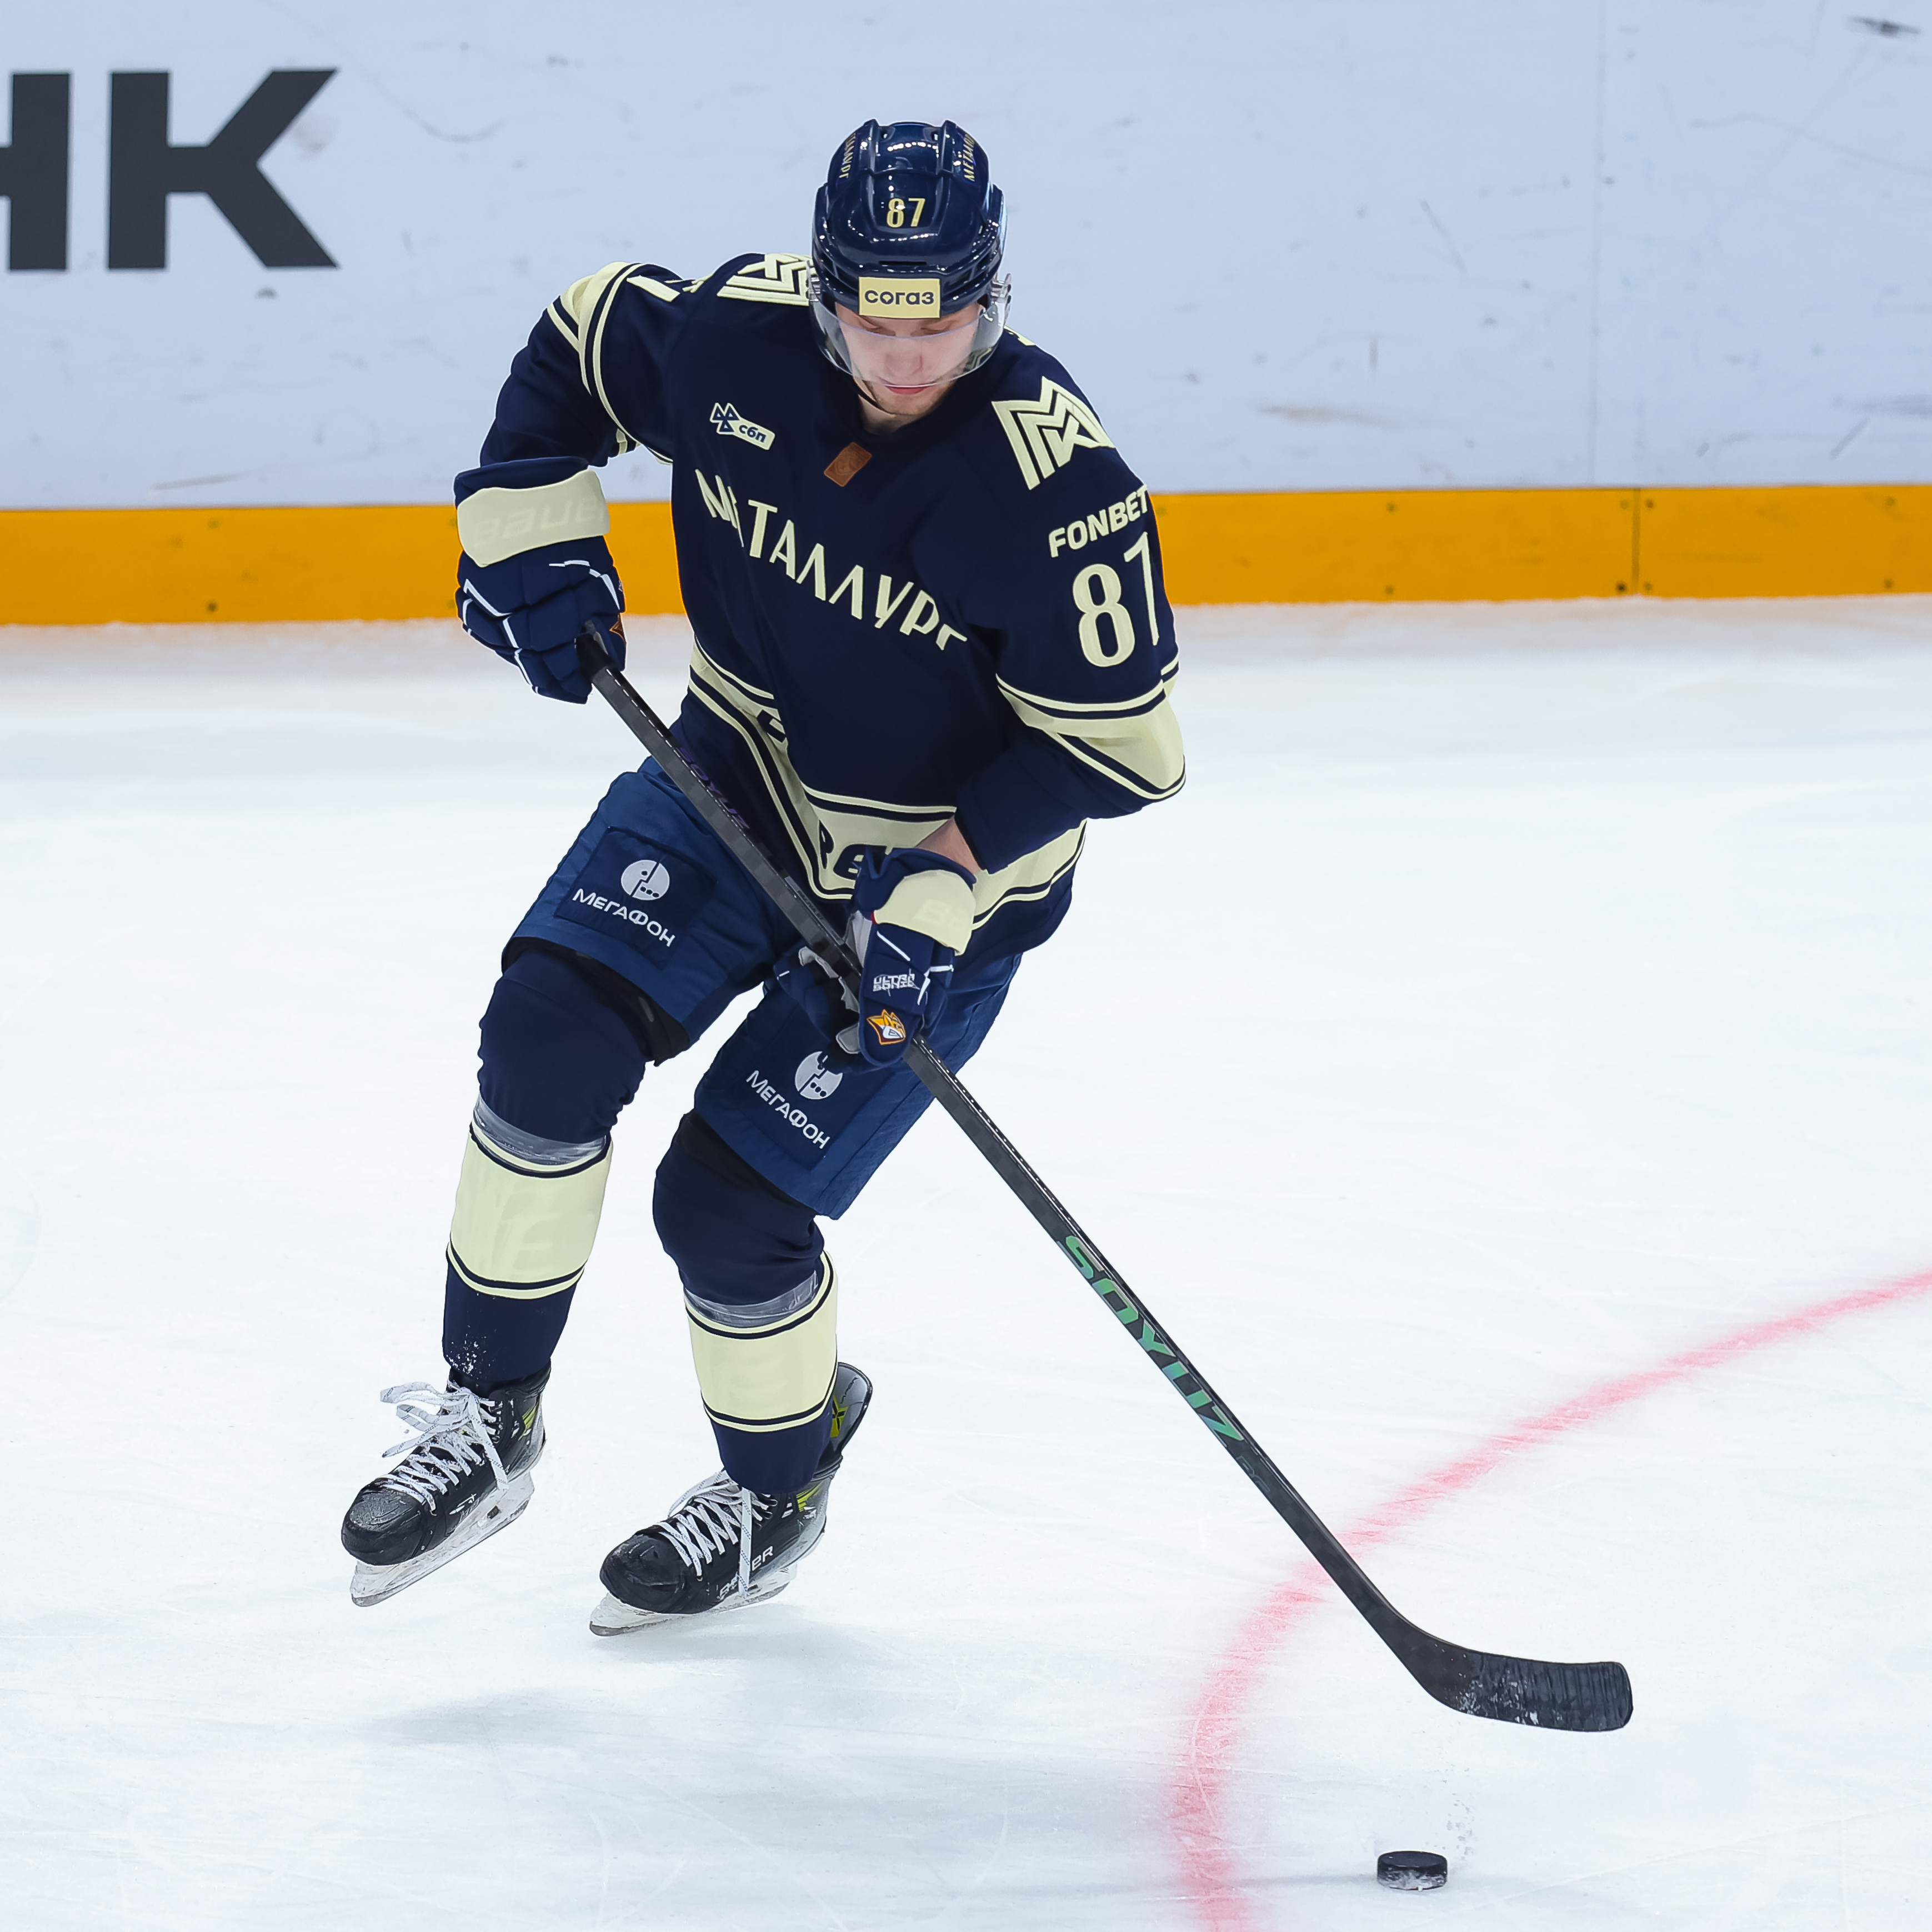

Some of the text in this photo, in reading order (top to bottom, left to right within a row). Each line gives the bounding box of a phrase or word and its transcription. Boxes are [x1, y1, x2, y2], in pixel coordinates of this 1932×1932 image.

[886, 197, 926, 228] 87
[739, 424, 767, 443] сбп
[1048, 484, 1148, 558] FONBET
[694, 468, 968, 651] МТАЛЛУРГ
[1072, 531, 1160, 668] 87
[572, 888, 675, 947] МЕГАФОН
[745, 1070, 830, 1149] МЕГАФОН
[1057, 1235, 1244, 1448] SOYUZ
